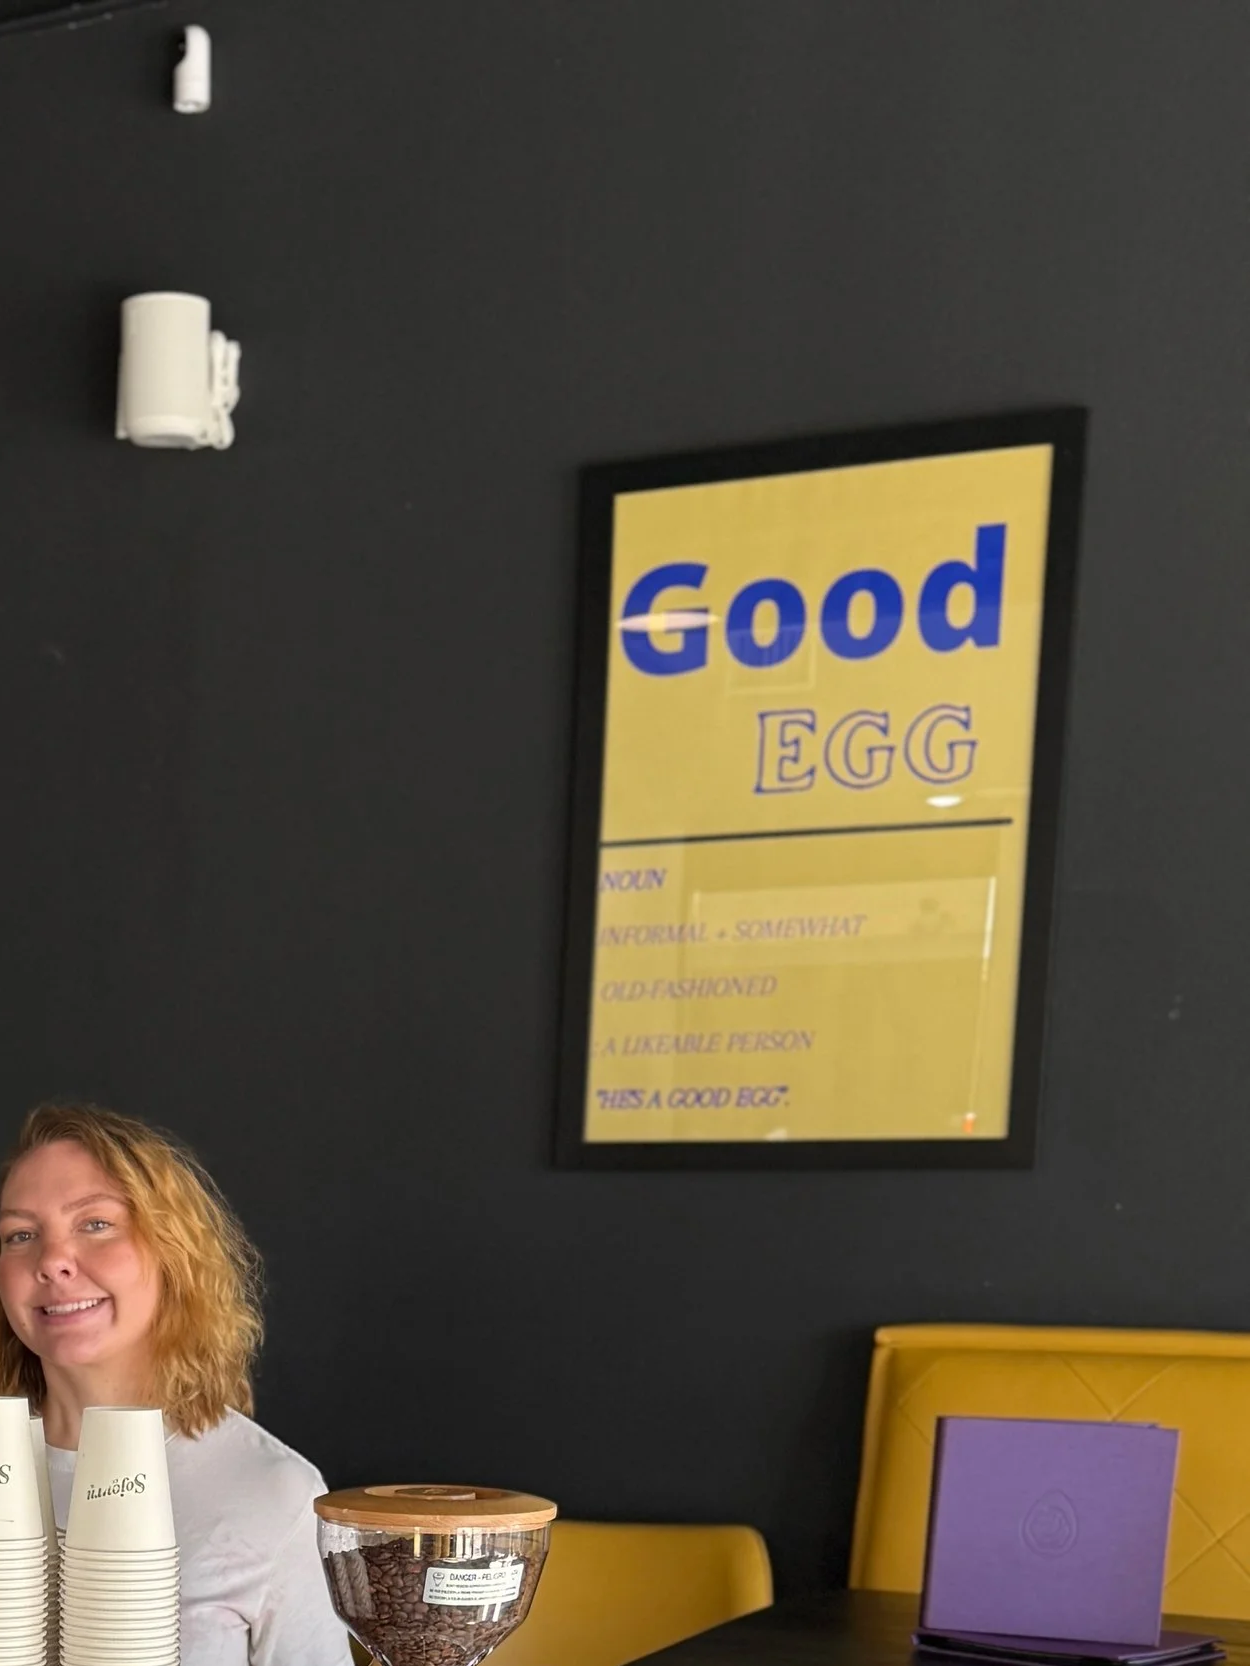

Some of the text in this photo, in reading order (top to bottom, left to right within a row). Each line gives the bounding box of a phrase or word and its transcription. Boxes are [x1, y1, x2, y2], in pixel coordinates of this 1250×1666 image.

[621, 523, 1007, 678] Good
[753, 703, 978, 795] EGG
[600, 869, 666, 891] NOUN
[598, 923, 708, 946] INFORMAL
[735, 915, 866, 940] SOMEWHAT
[601, 975, 779, 1003] OLD-FASHIONED
[621, 1031, 723, 1057] LIKEABLE
[726, 1029, 817, 1053] PERSON
[648, 1089, 663, 1110] A
[667, 1087, 732, 1109] GOOD
